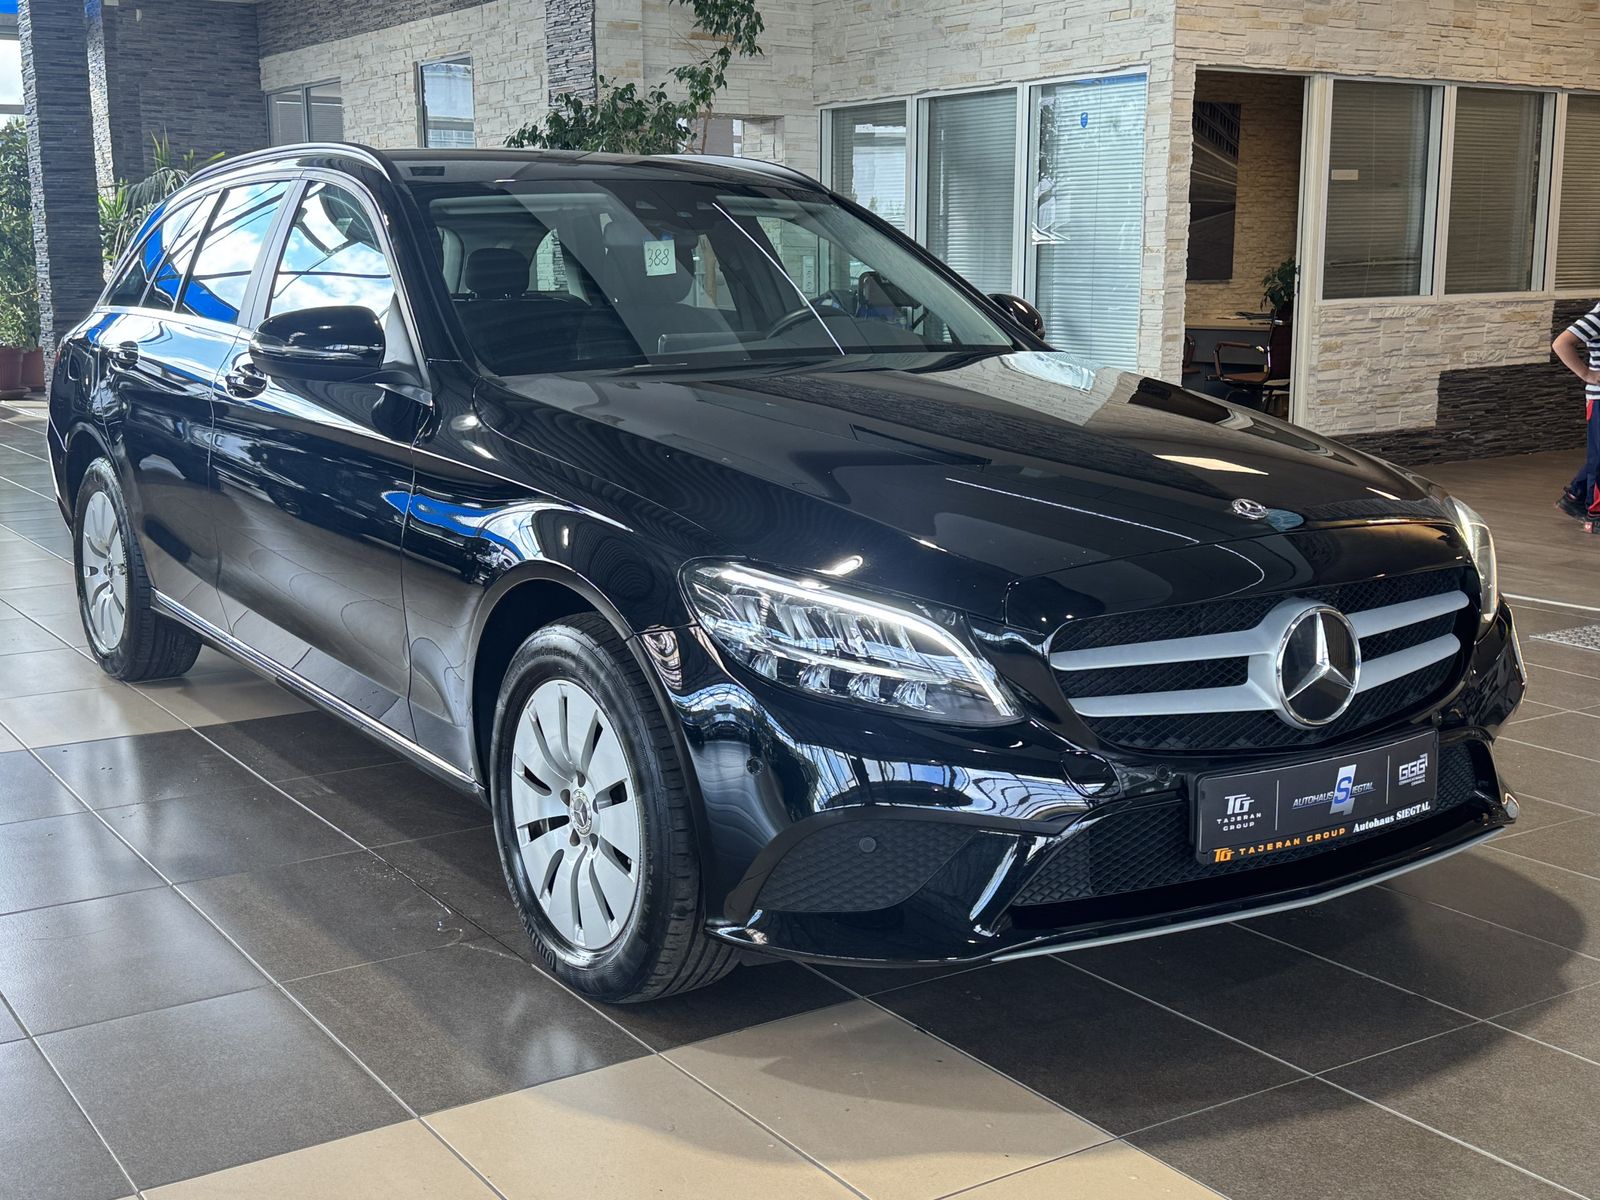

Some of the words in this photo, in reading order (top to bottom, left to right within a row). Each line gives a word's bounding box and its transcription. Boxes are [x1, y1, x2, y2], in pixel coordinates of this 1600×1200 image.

[648, 247, 669, 268] 388
[1293, 791, 1334, 808] AUTOHAUS
[1216, 813, 1262, 825] TAJERAN
[1222, 821, 1255, 831] GROUP
[1239, 837, 1301, 855] TAJERAN
[1306, 827, 1346, 842] GROUP
[1353, 815, 1395, 833] Autohaus
[1396, 801, 1431, 820] SIEGTAL
